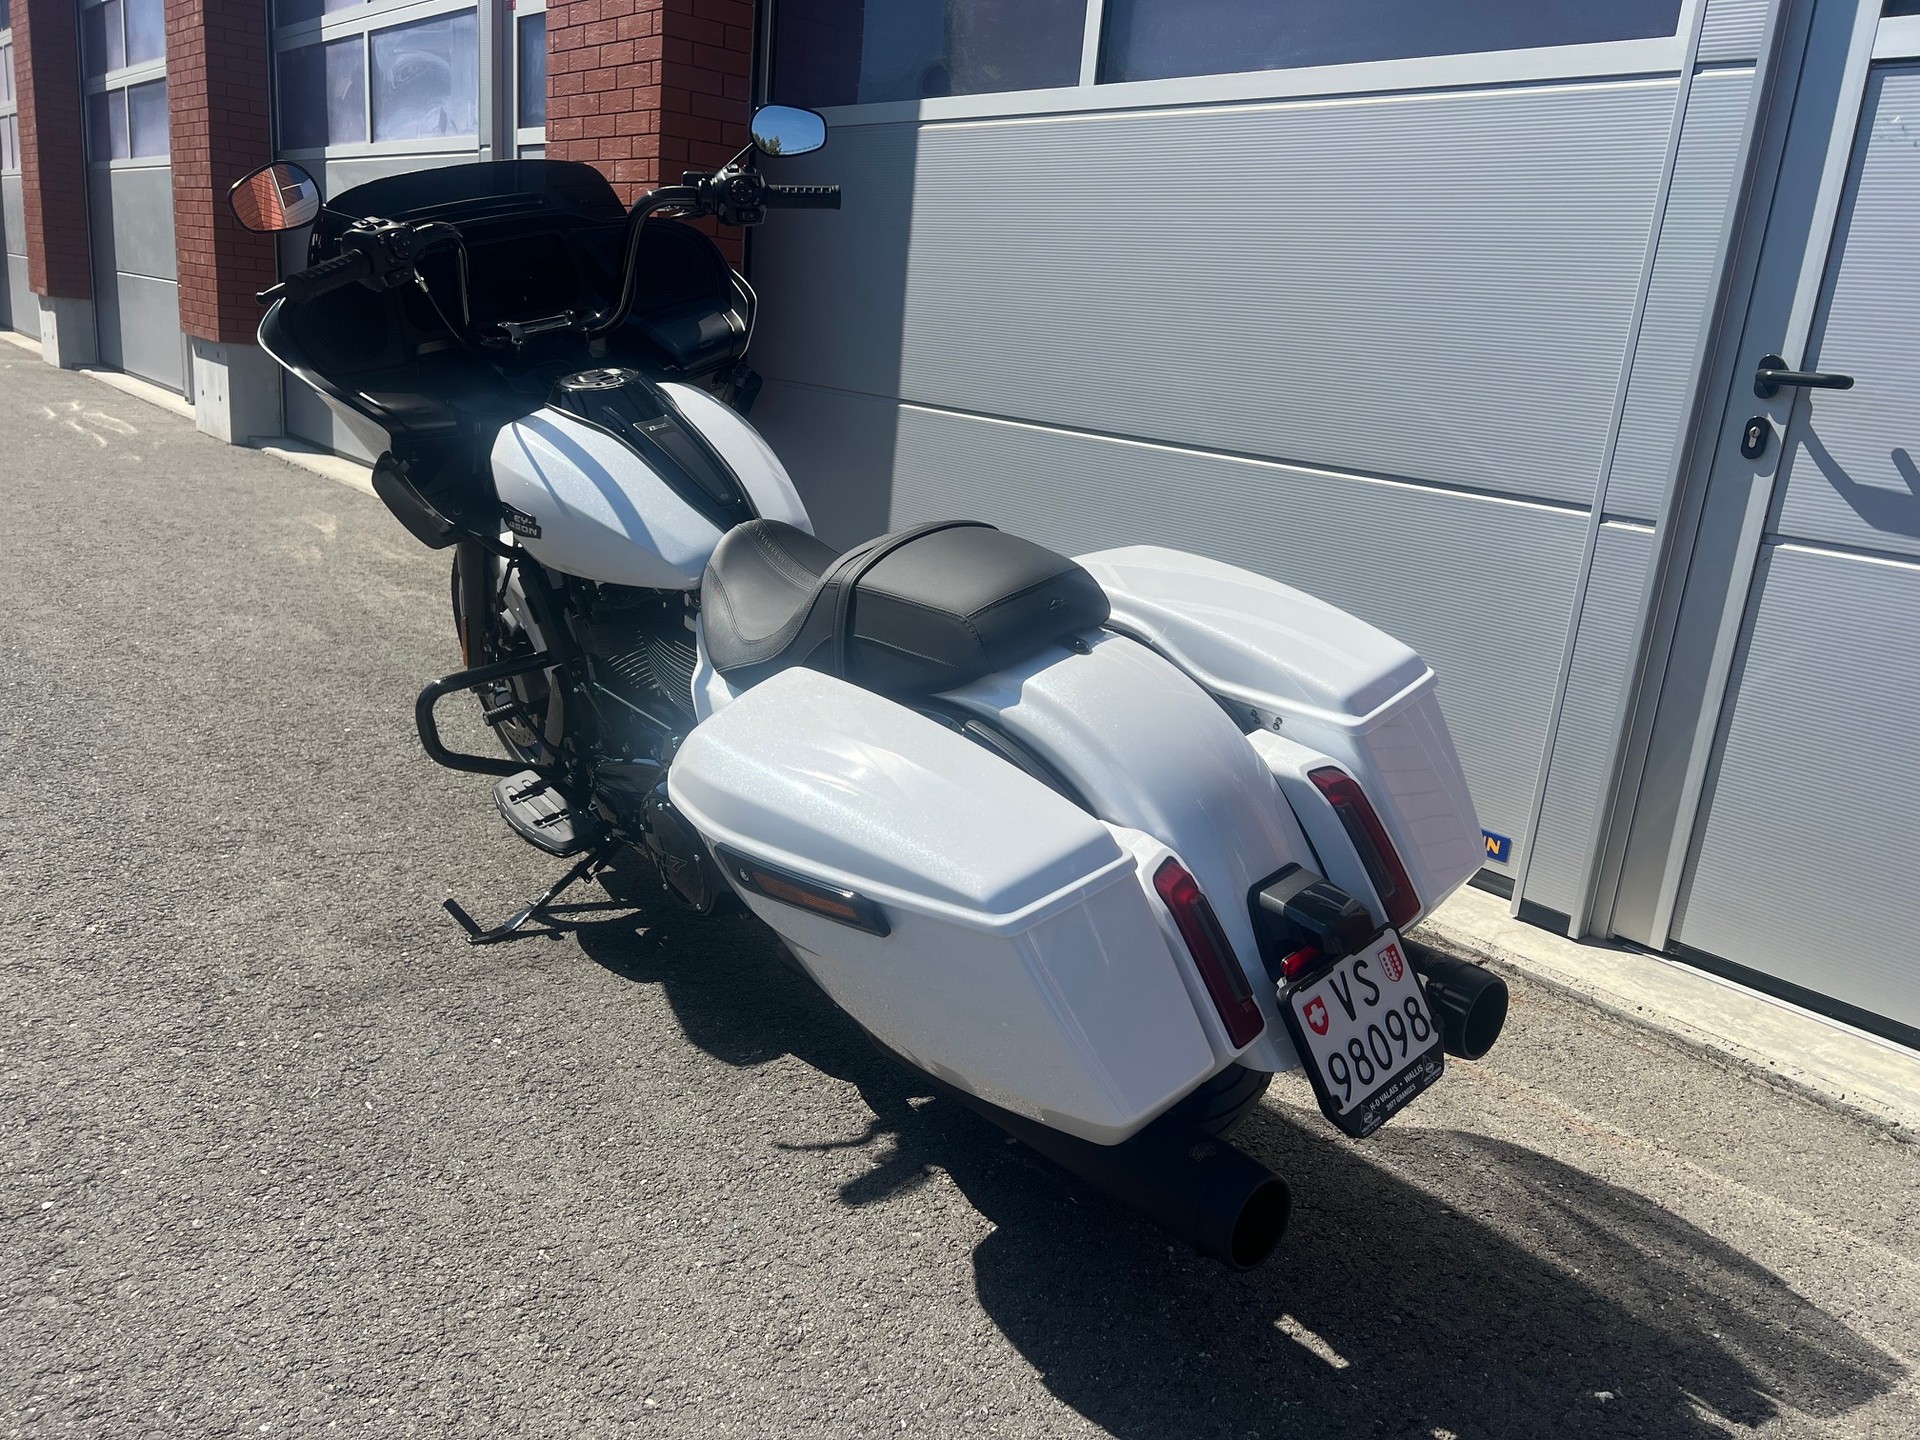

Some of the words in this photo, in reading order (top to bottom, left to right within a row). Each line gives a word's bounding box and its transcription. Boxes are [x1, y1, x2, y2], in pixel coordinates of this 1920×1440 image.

[1328, 959, 1380, 1022] VS
[1327, 996, 1431, 1103] 98098
[1380, 1084, 1399, 1102] VALAIS
[1403, 1064, 1424, 1084] WALLIS
